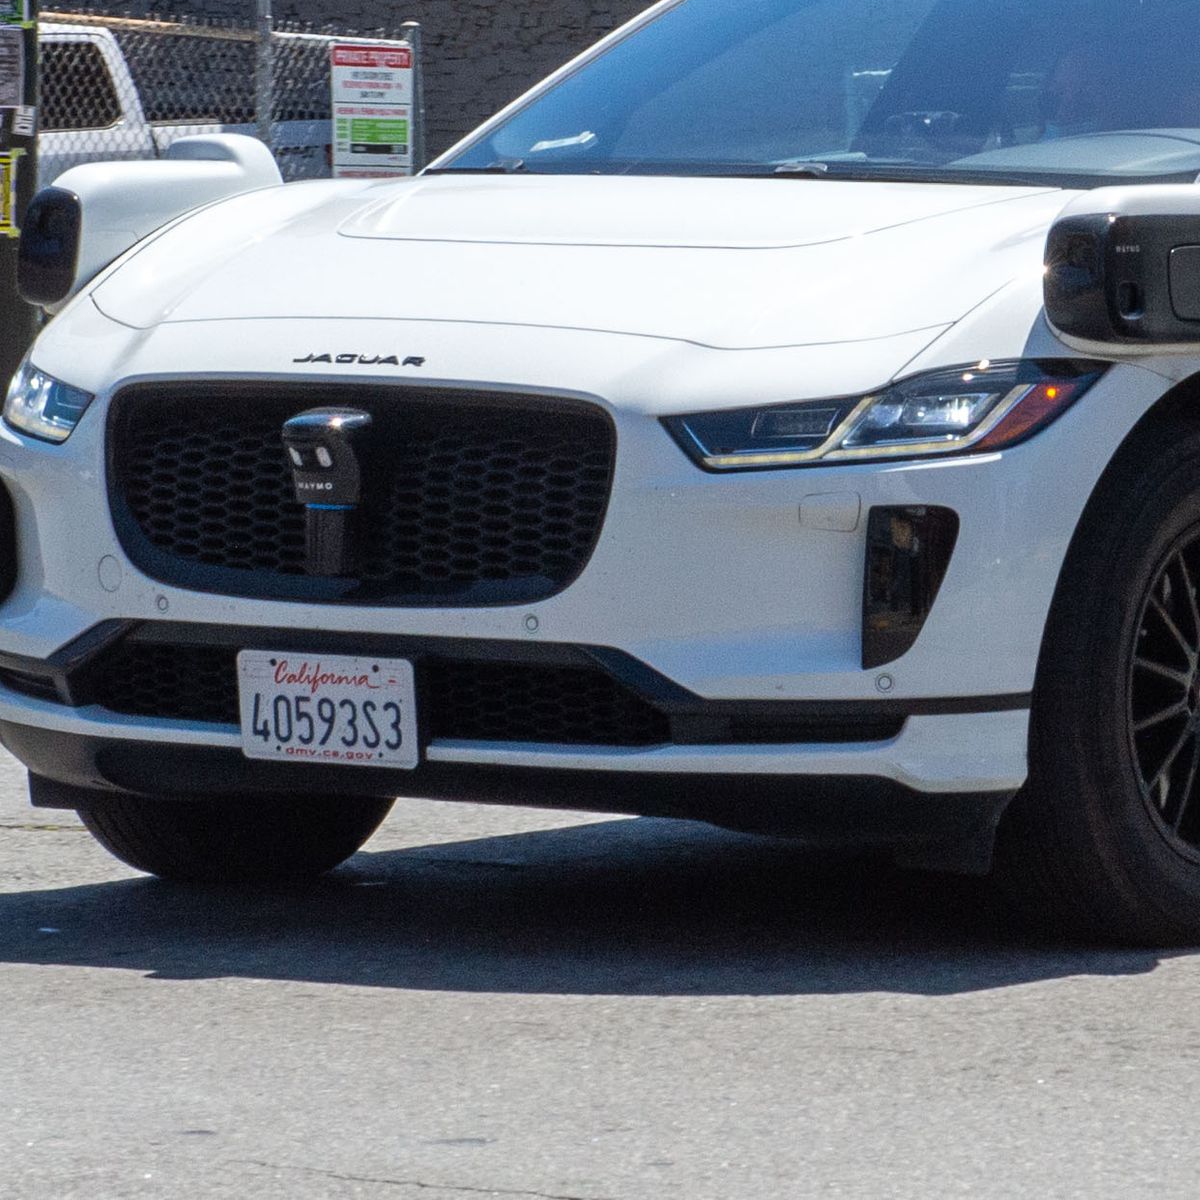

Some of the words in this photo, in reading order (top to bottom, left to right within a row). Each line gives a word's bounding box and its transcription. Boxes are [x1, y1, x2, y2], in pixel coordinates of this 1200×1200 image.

[292, 353, 426, 367] JAGUAR
[298, 482, 333, 491] WAYMO
[274, 659, 381, 693] California
[252, 692, 403, 750] 40593S3
[285, 746, 374, 760] dmv.ca.gov
